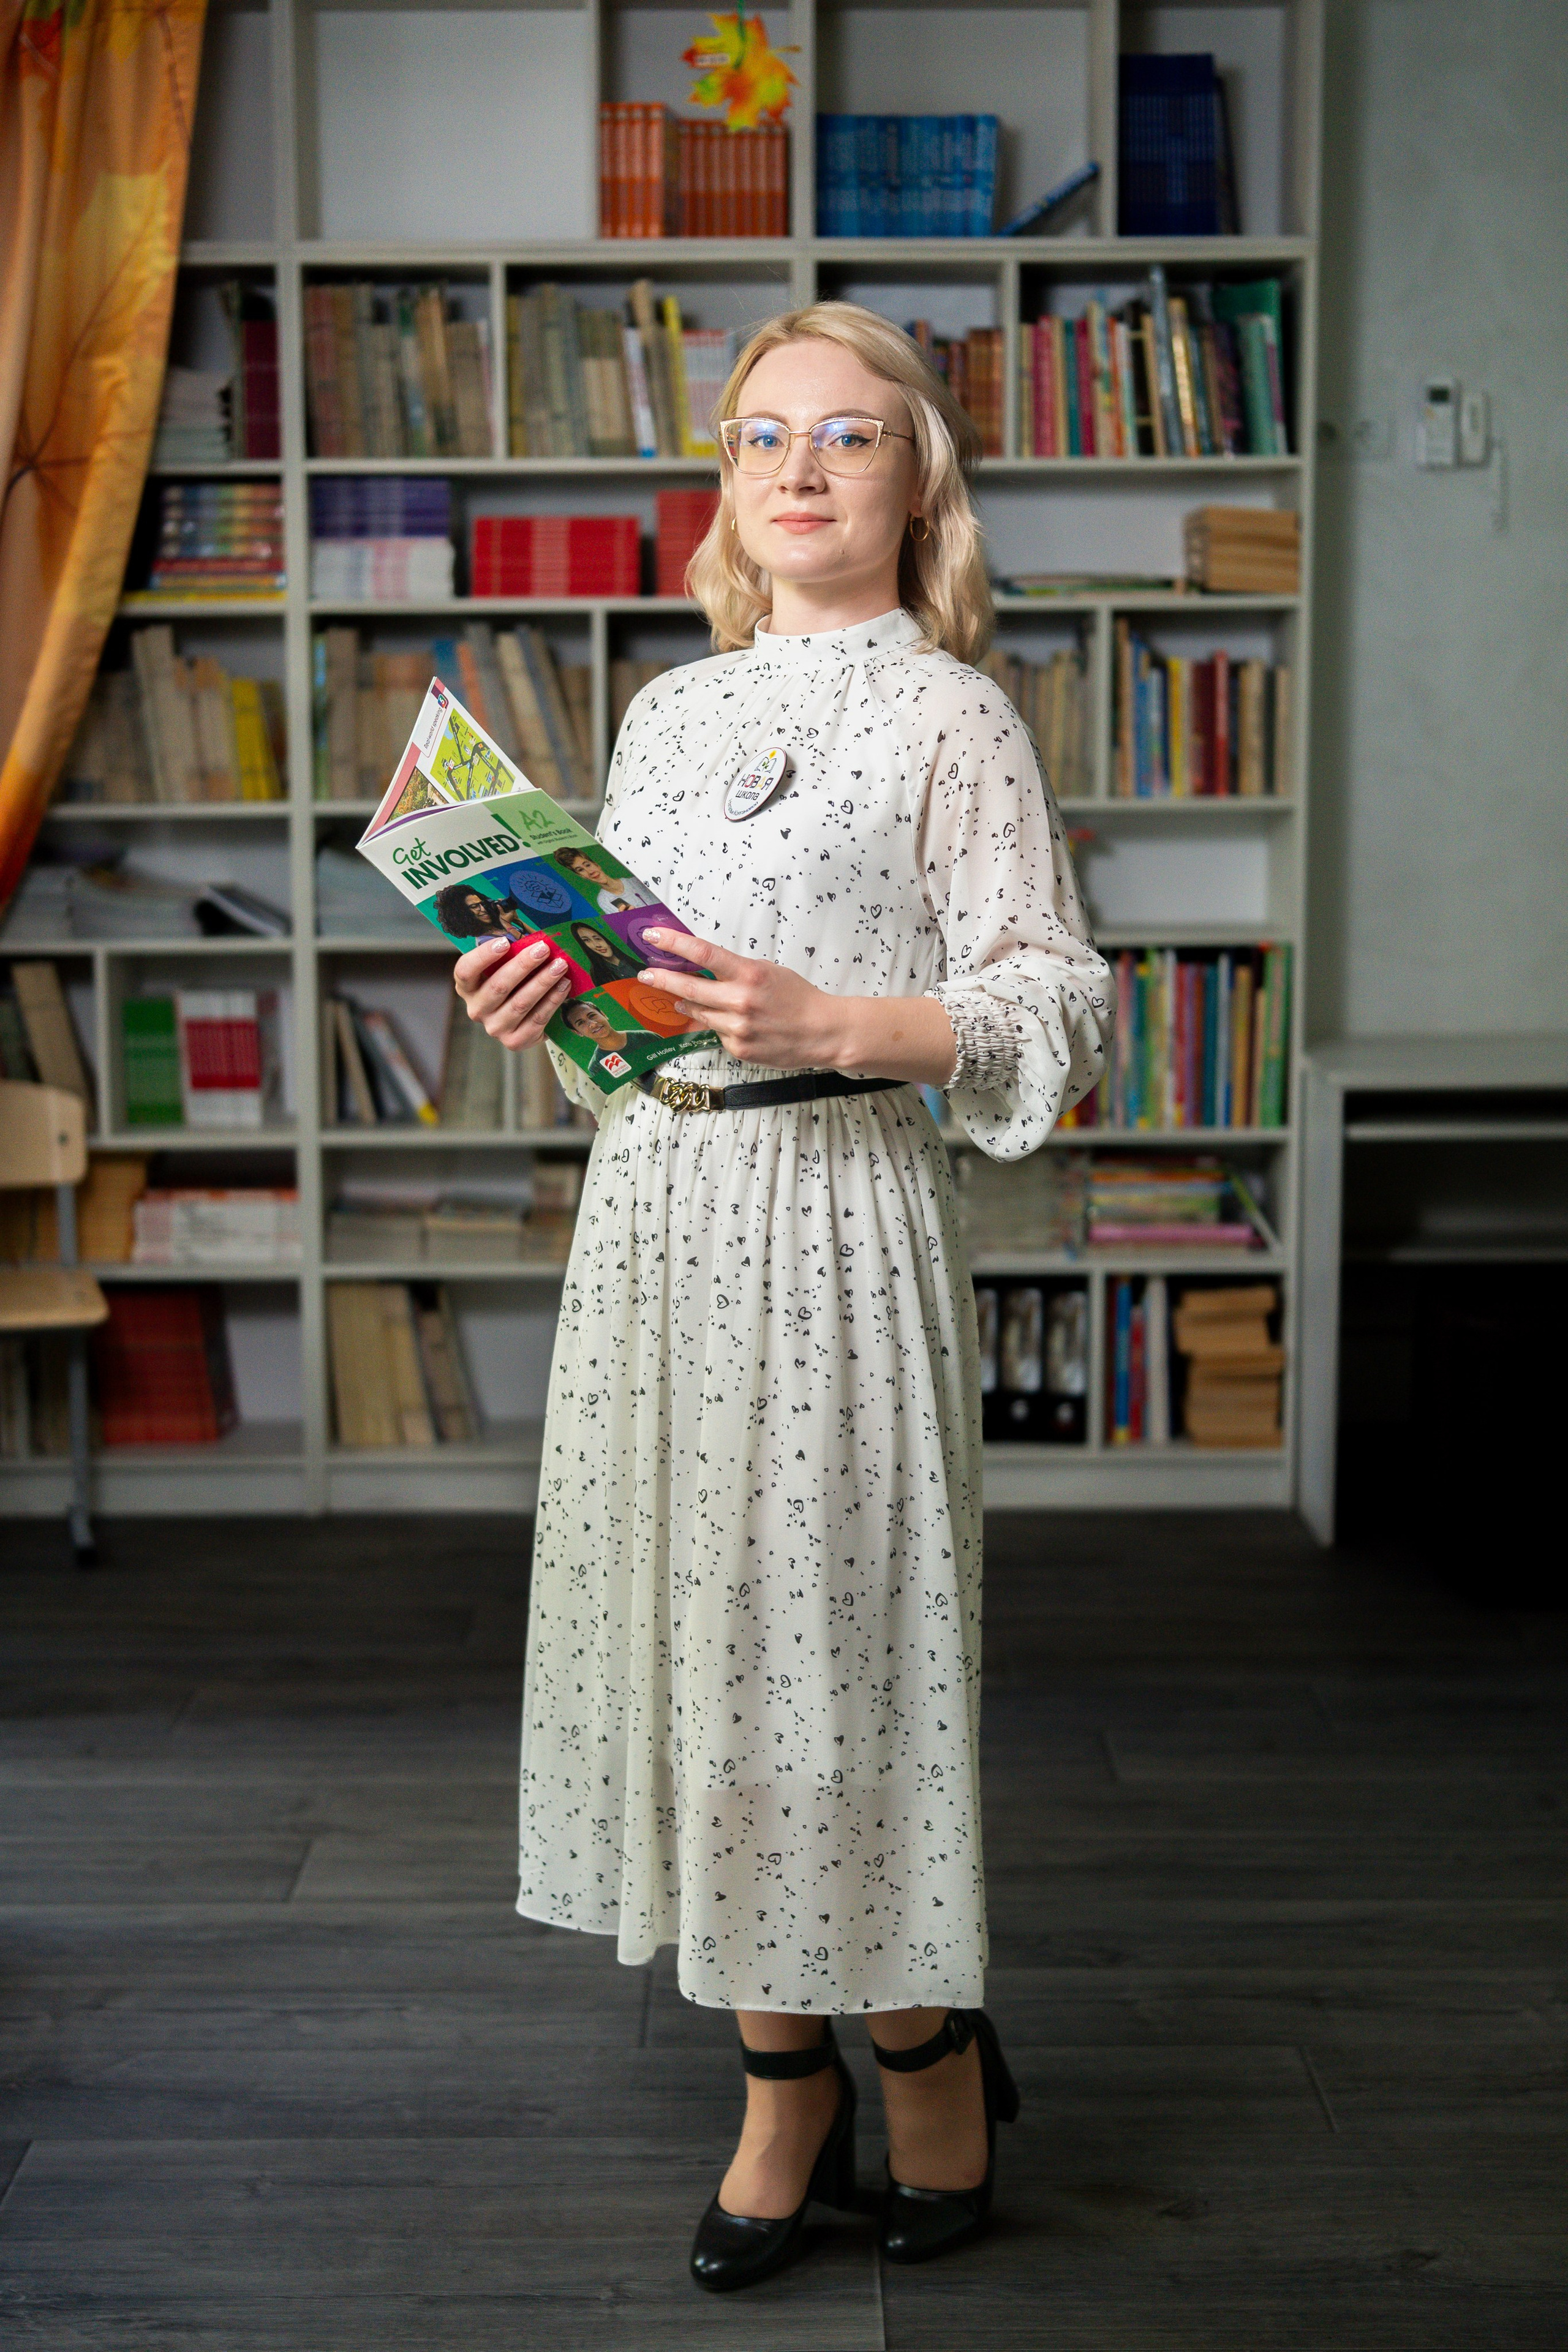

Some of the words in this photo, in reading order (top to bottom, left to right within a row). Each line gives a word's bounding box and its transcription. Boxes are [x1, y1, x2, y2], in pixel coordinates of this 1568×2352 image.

[432, 707, 443, 728] speaking
[737, 774, 774, 791] НОВАЯ
[735, 790, 760, 801] школа
[518, 809, 556, 831] A2
[392, 837, 431, 865] Get
[646, 1052, 658, 1061] Gill
[658, 1046, 676, 1057] Holley
[679, 1041, 692, 1049] Kate
